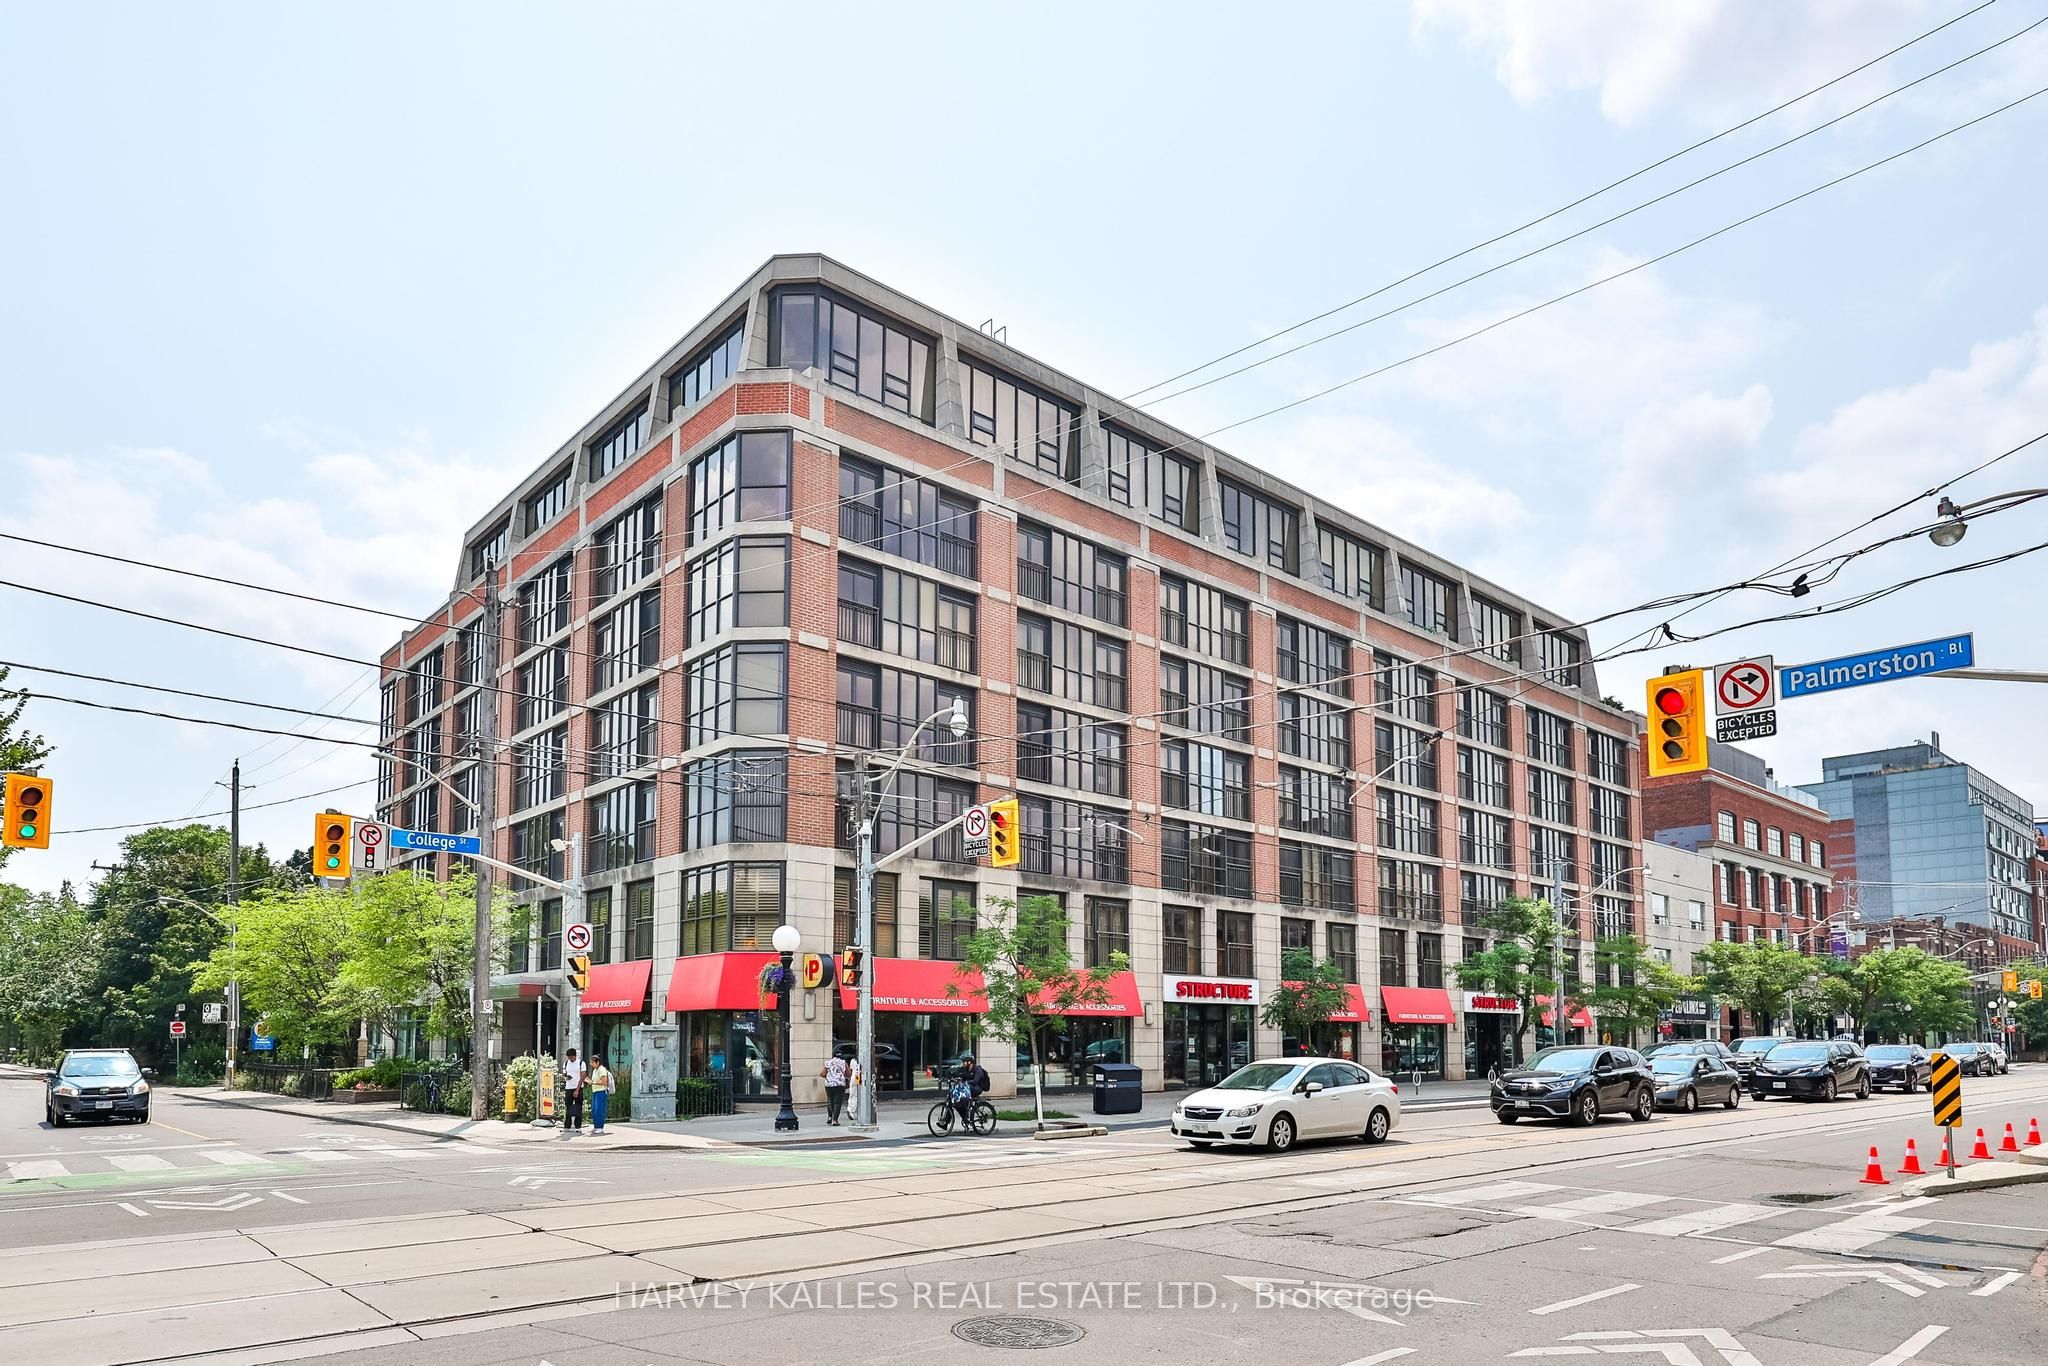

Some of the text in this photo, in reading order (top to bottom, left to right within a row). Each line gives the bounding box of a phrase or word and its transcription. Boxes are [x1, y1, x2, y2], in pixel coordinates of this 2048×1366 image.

[1790, 641, 1963, 692] Palmerston Bl
[1717, 712, 1774, 730] BICYCLES
[1719, 724, 1774, 741] EXCEPTED
[407, 833, 456, 851] College
[808, 960, 820, 981] P
[1176, 981, 1252, 1000] STRUCTUBE
[604, 1000, 631, 1008] ACCESSORIES
[910, 998, 917, 1006] &
[919, 998, 969, 1007] ACCESSORIES
